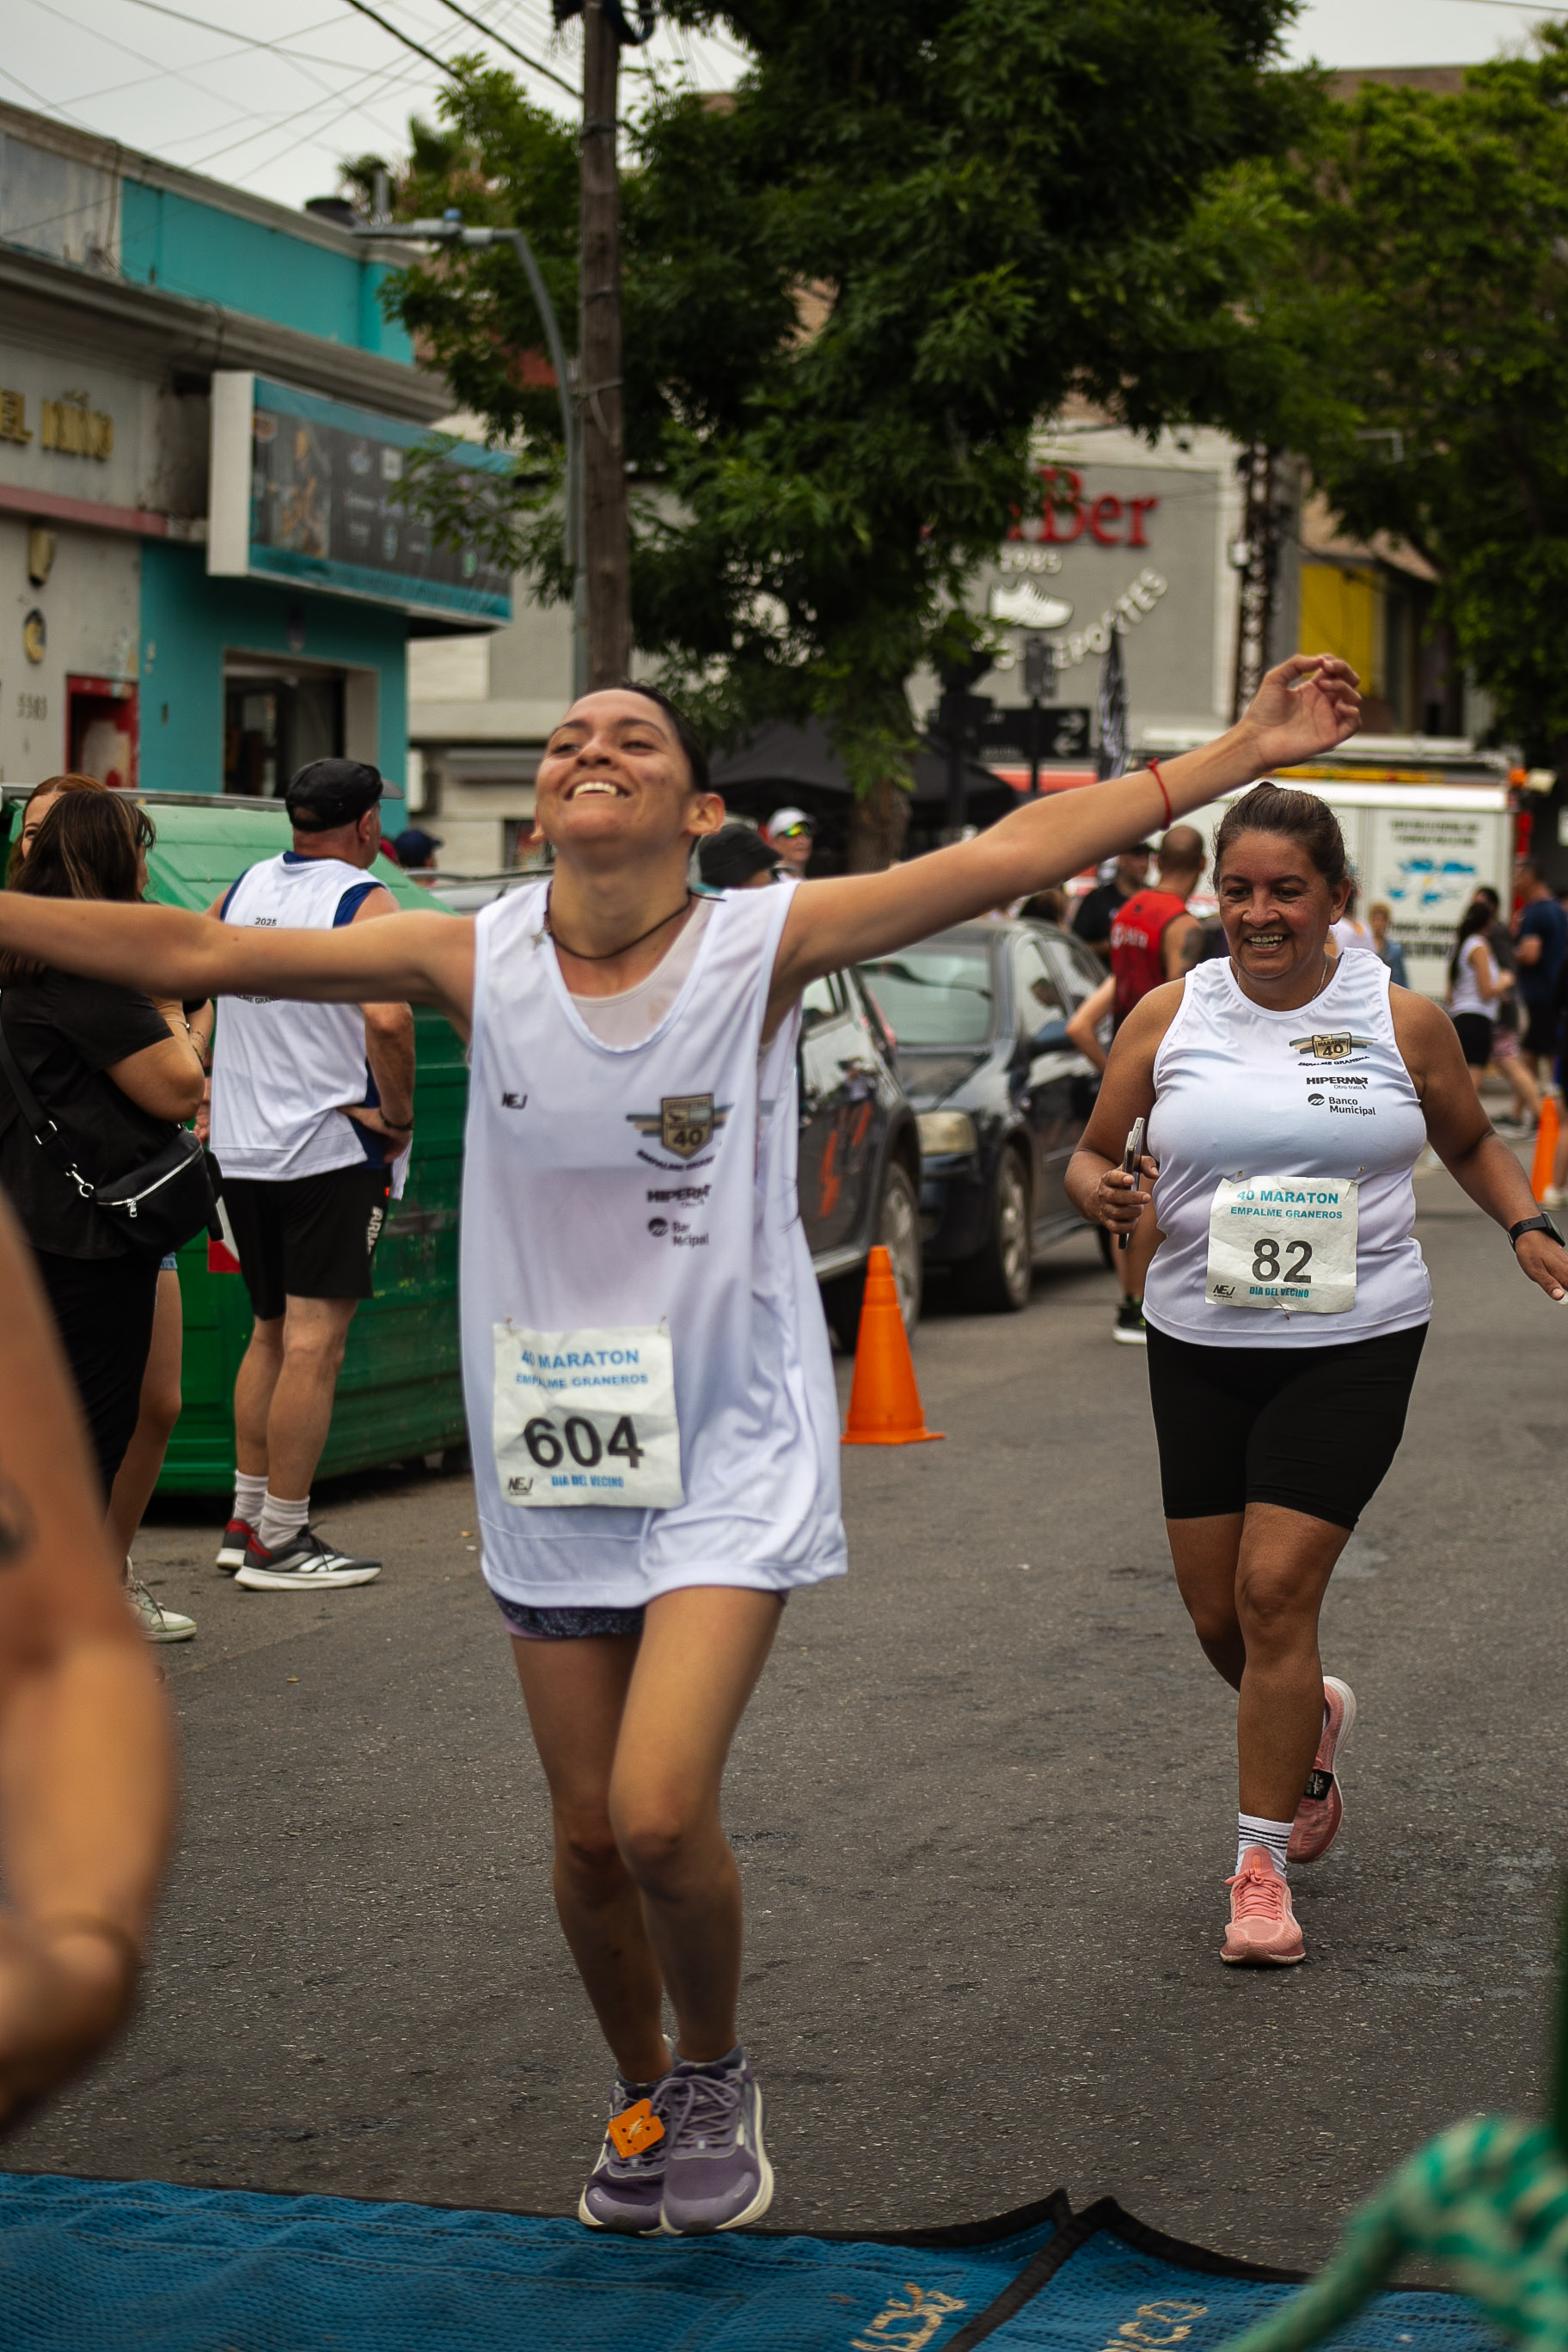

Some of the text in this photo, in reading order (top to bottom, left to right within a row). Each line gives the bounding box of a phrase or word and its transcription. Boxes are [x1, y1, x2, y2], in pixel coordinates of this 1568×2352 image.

[254, 916, 278, 927] 2025
[1322, 1044, 1344, 1057] 40
[501, 1093, 528, 1110] NEJ
[1328, 1096, 1358, 1106] Banco
[1329, 1106, 1376, 1117] Municipal
[673, 1130, 703, 1148] 40
[1236, 1190, 1338, 1204] 40 MARATON
[1230, 1206, 1343, 1219] EMPALME GRANEROS
[1252, 1238, 1313, 1283] 82
[1213, 1284, 1309, 1298] NEJ DIA DEL VECINO
[537, 1350, 640, 1369] MARATON
[572, 1373, 648, 1388] GRANEROS
[524, 1415, 644, 1469] 604
[508, 1477, 534, 1491] NEJ
